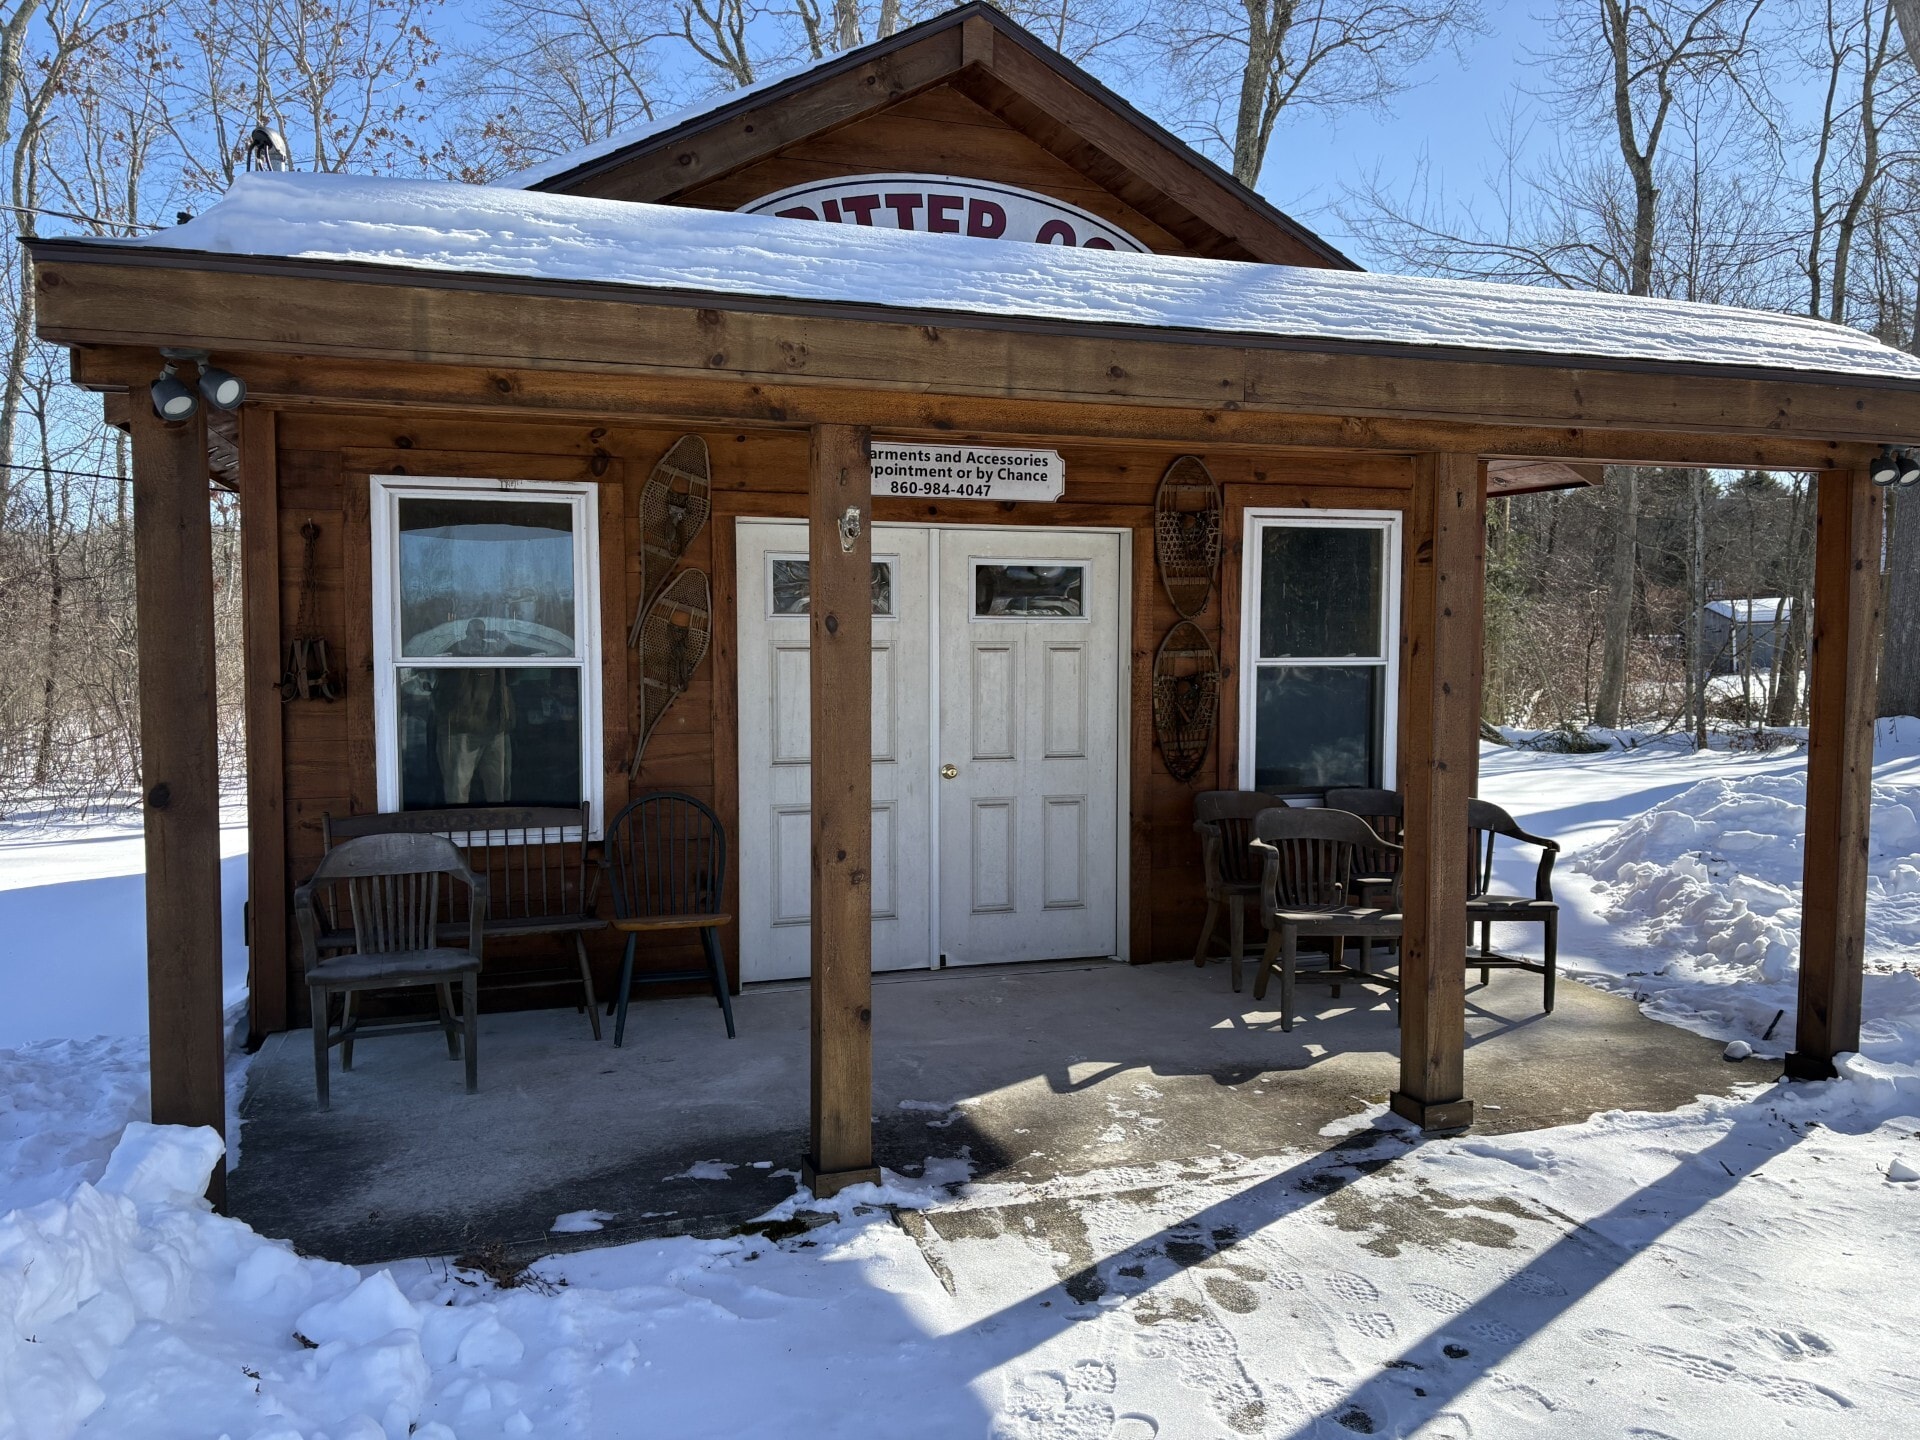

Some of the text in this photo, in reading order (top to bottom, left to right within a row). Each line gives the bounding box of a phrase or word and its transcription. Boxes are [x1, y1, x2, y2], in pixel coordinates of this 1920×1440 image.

[935, 450, 962, 463] and
[966, 452, 1049, 467] Accessories
[871, 464, 1048, 483] pointment or by Chance
[890, 481, 992, 497] 860-984-4047
